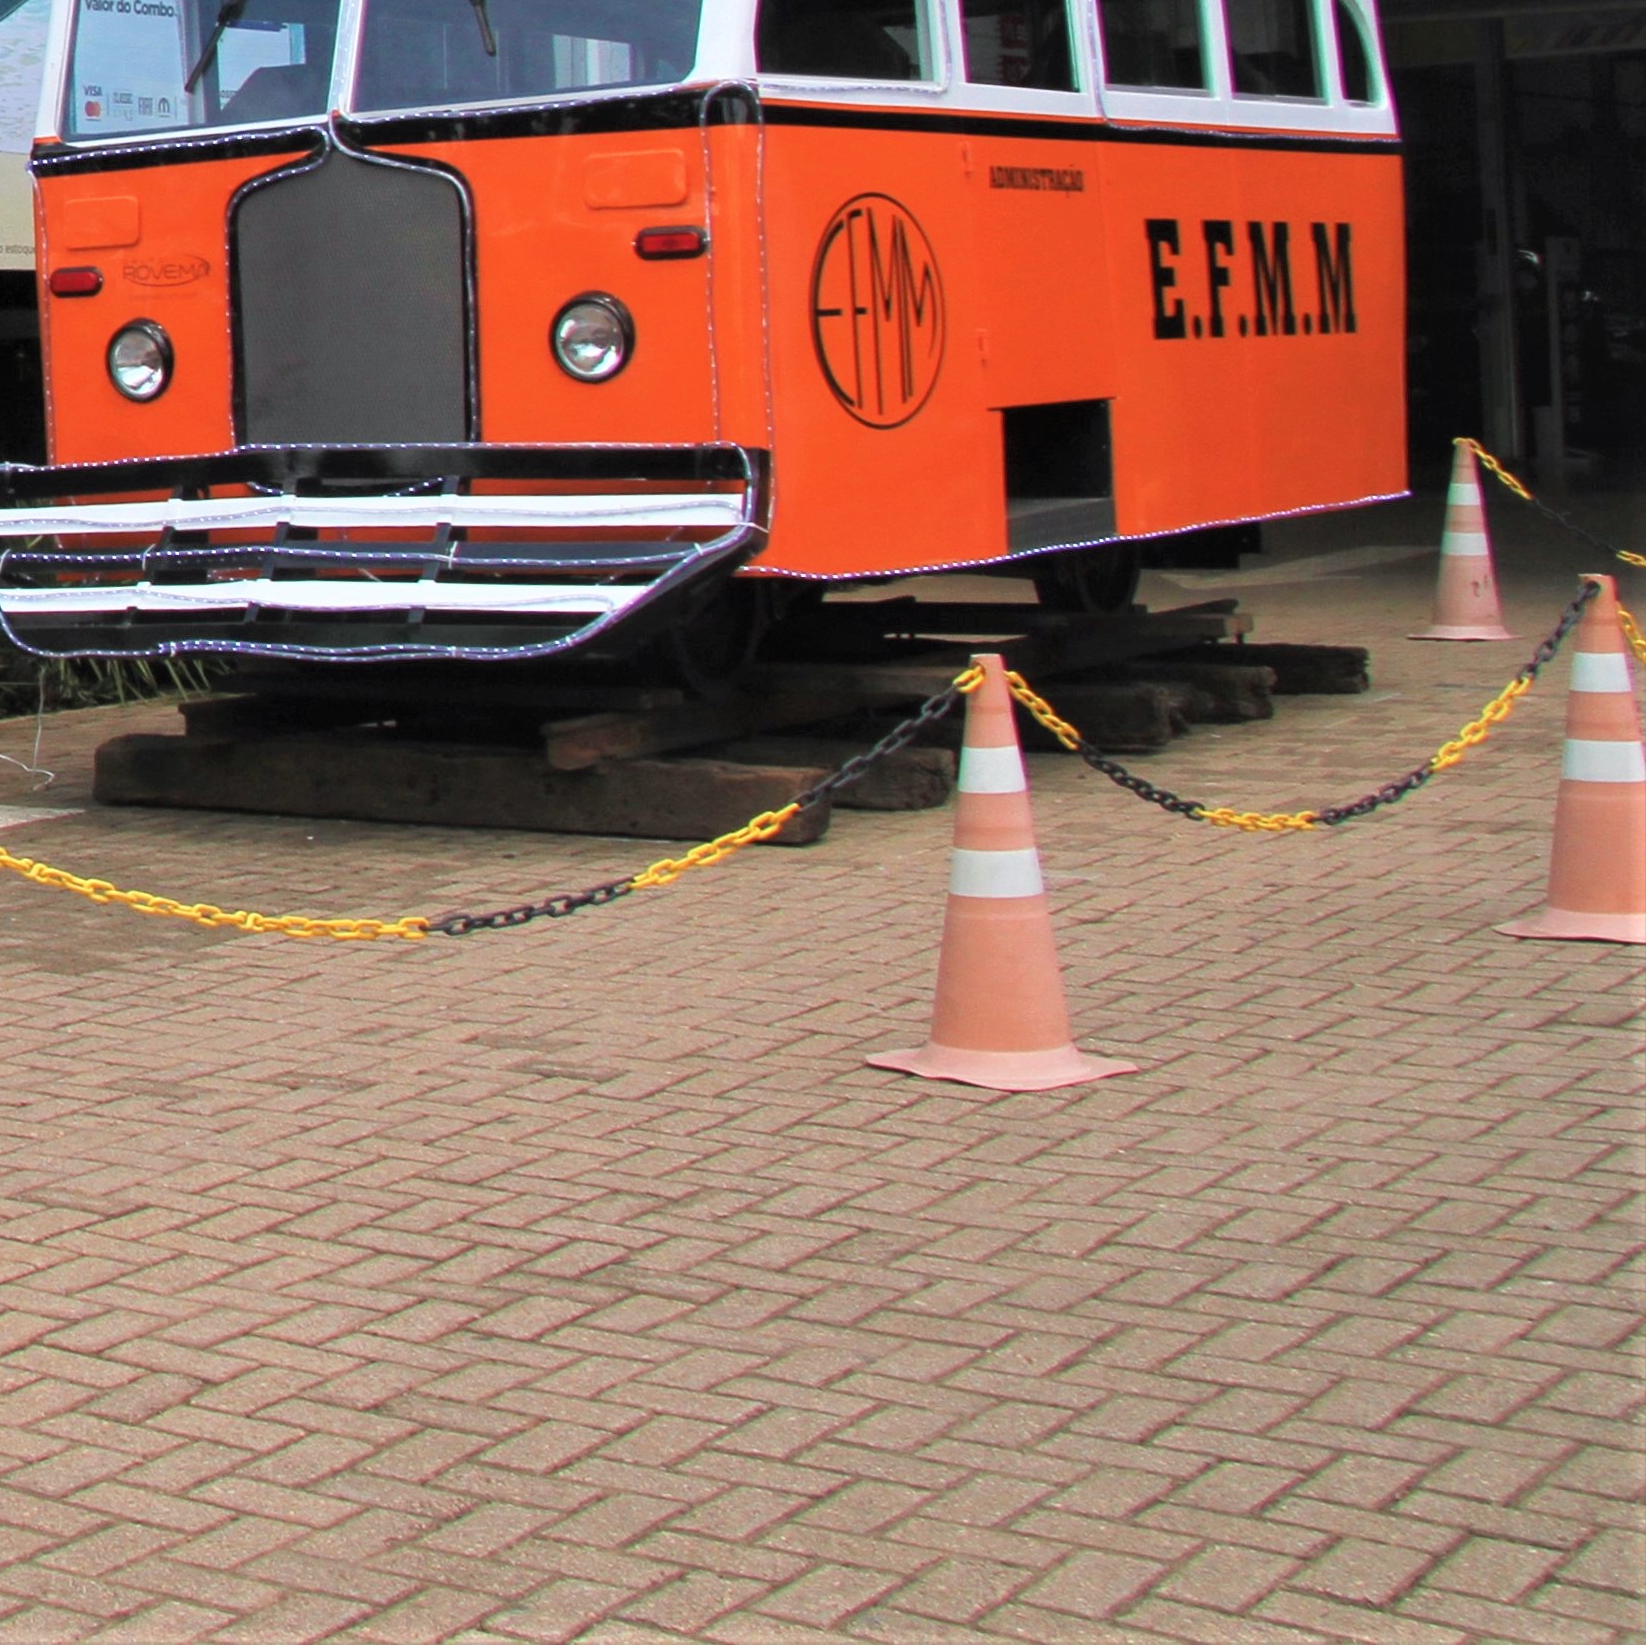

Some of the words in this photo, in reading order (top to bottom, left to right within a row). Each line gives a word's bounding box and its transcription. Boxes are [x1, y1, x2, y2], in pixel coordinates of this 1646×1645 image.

[83, 85, 103, 98] VISA
[989, 164, 1084, 199] ADMINISTRAÇÃO
[1145, 218, 1357, 341] E.F.M.M
